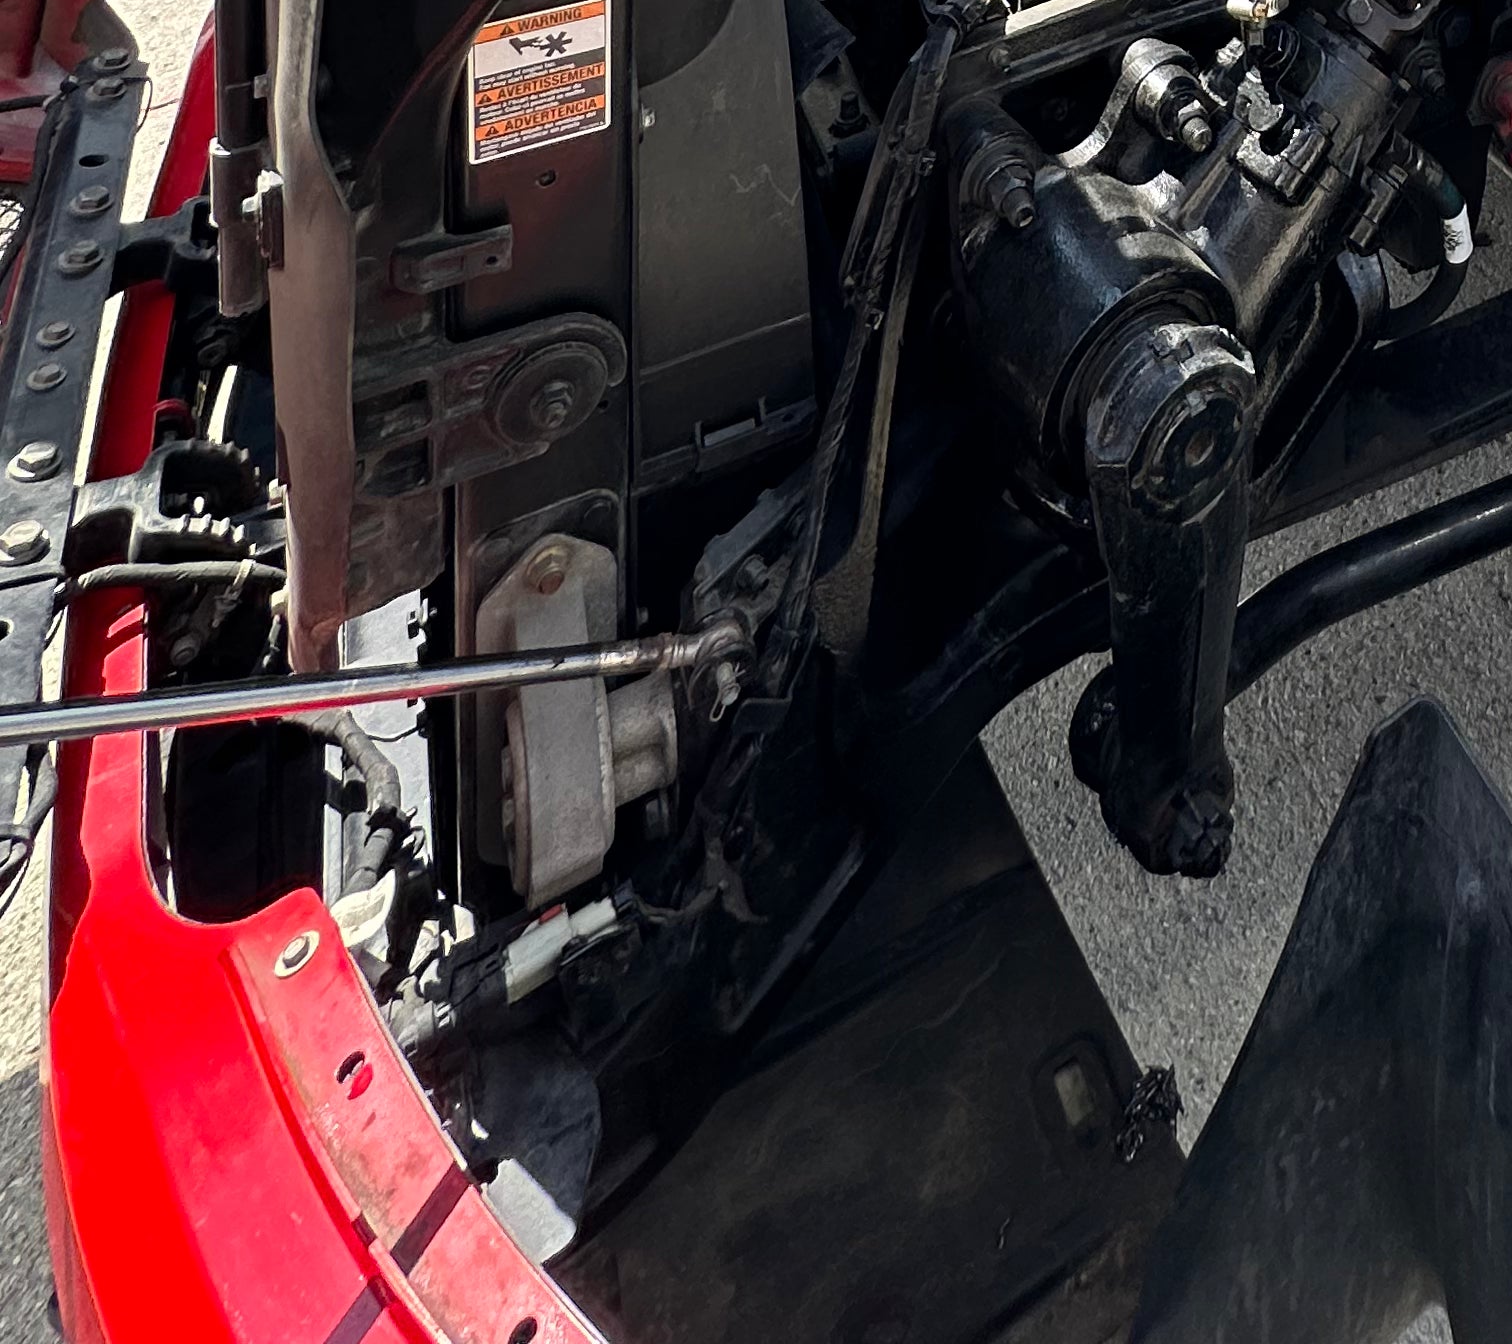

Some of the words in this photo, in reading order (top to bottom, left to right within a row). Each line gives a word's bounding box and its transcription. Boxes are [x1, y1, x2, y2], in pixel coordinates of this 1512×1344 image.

[517, 9, 582, 32] WARNING
[497, 65, 602, 100] AVERTISSEMENT
[504, 99, 597, 132] ADVERTENCIA
